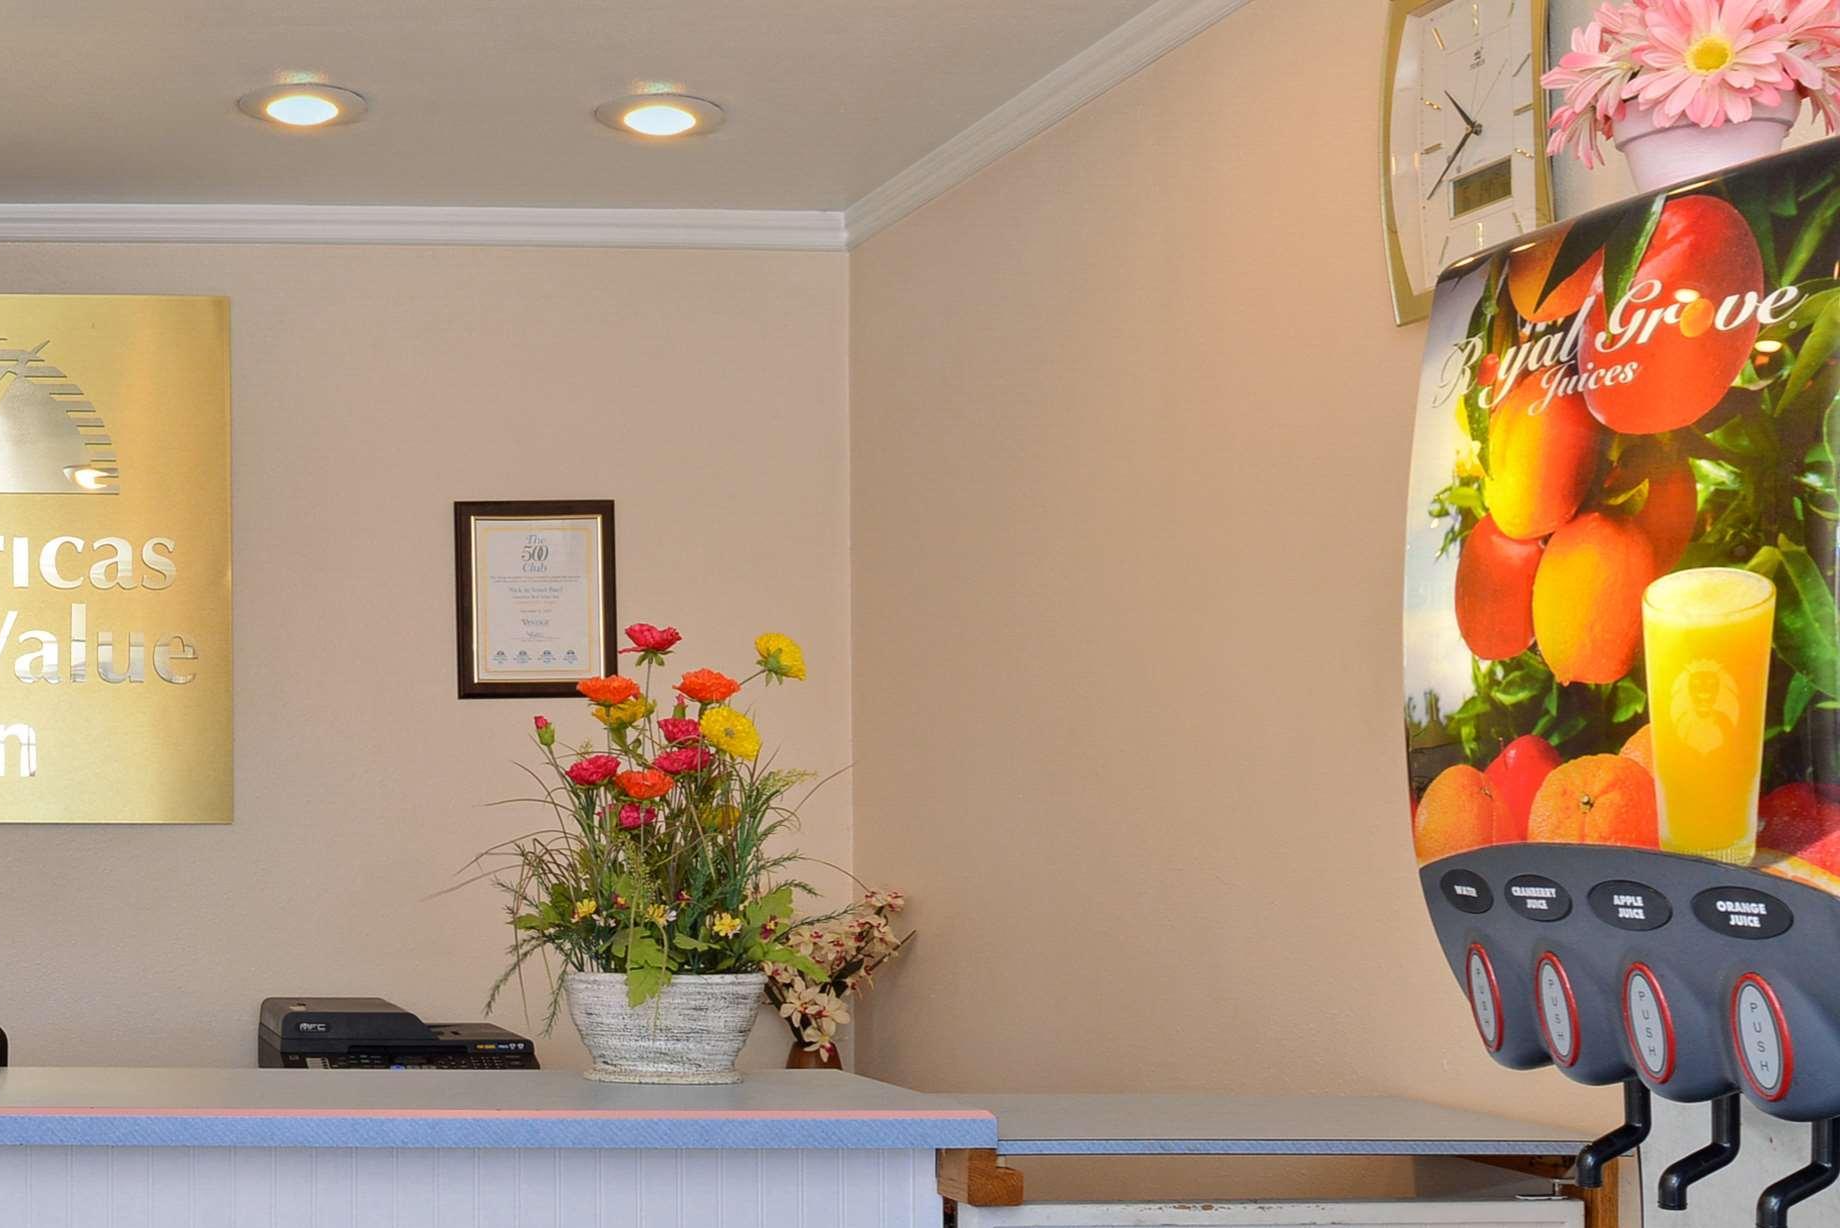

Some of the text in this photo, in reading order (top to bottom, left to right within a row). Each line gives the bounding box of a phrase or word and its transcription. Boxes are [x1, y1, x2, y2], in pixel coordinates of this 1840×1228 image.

[1432, 279, 1809, 409] Royal Grove
[1527, 360, 1639, 416] Juices
[521, 545, 549, 561] 500
[1511, 886, 1556, 898] CRANBERRY
[1526, 899, 1548, 909] JUICE
[1613, 894, 1644, 907] APPLE
[1716, 900, 1768, 915] ORANGE
[1618, 908, 1646, 920] JUICE
[1729, 914, 1761, 928] JUICE
[1638, 991, 1657, 1056] PUSH
[1749, 1002, 1770, 1072] PUSH
